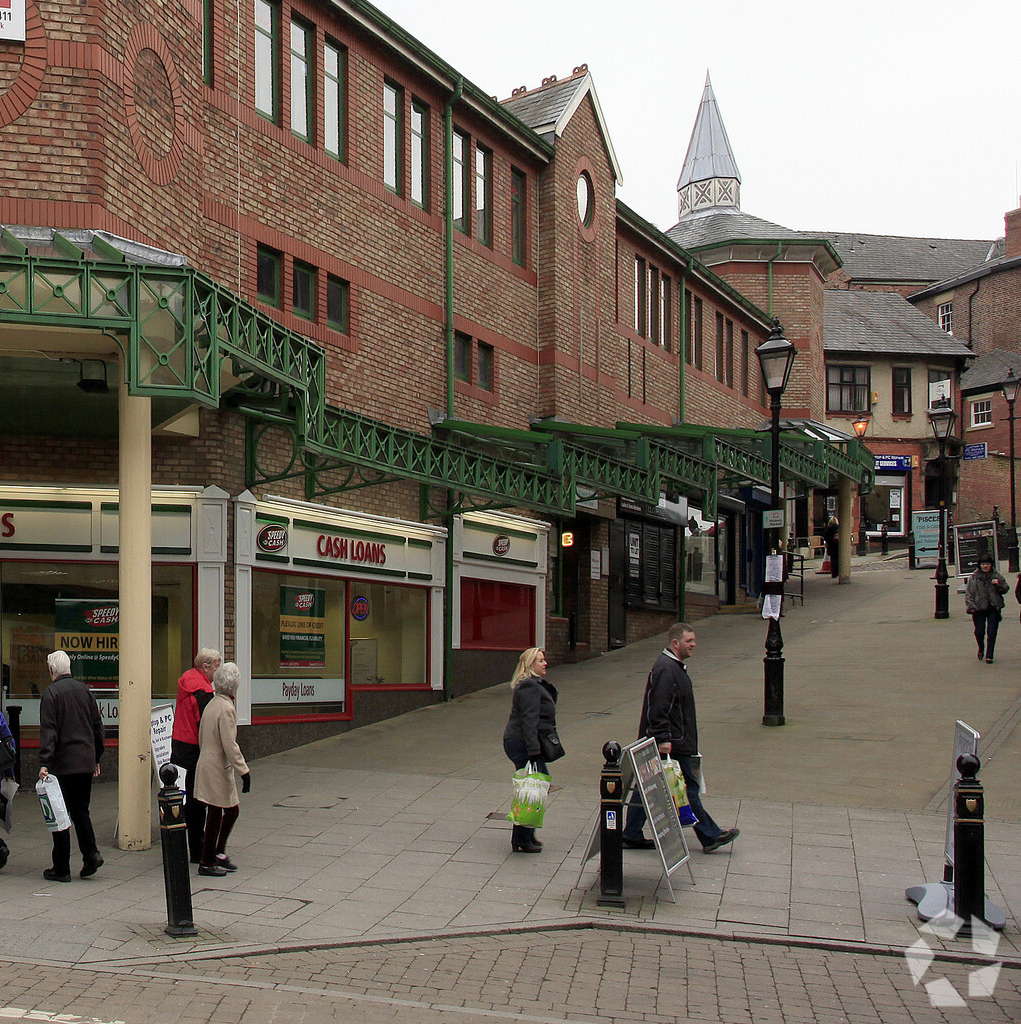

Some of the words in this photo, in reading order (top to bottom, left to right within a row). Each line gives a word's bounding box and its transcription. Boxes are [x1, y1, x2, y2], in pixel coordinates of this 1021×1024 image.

[267, 530, 285, 539] SPEEDY
[268, 539, 284, 547] CASH
[317, 535, 348, 560] CASH
[351, 539, 386, 565] LOANS
[298, 593, 314, 603] SPEEDY
[92, 606, 119, 618] SPEEDY
[352, 602, 370, 615] OPEN
[60, 636, 93, 649] NOW
[96, 636, 118, 649] HIR
[282, 681, 300, 700] Payday
[300, 682, 315, 696] Loans
[164, 714, 172, 723] PC
[153, 725, 167, 735] Repair
